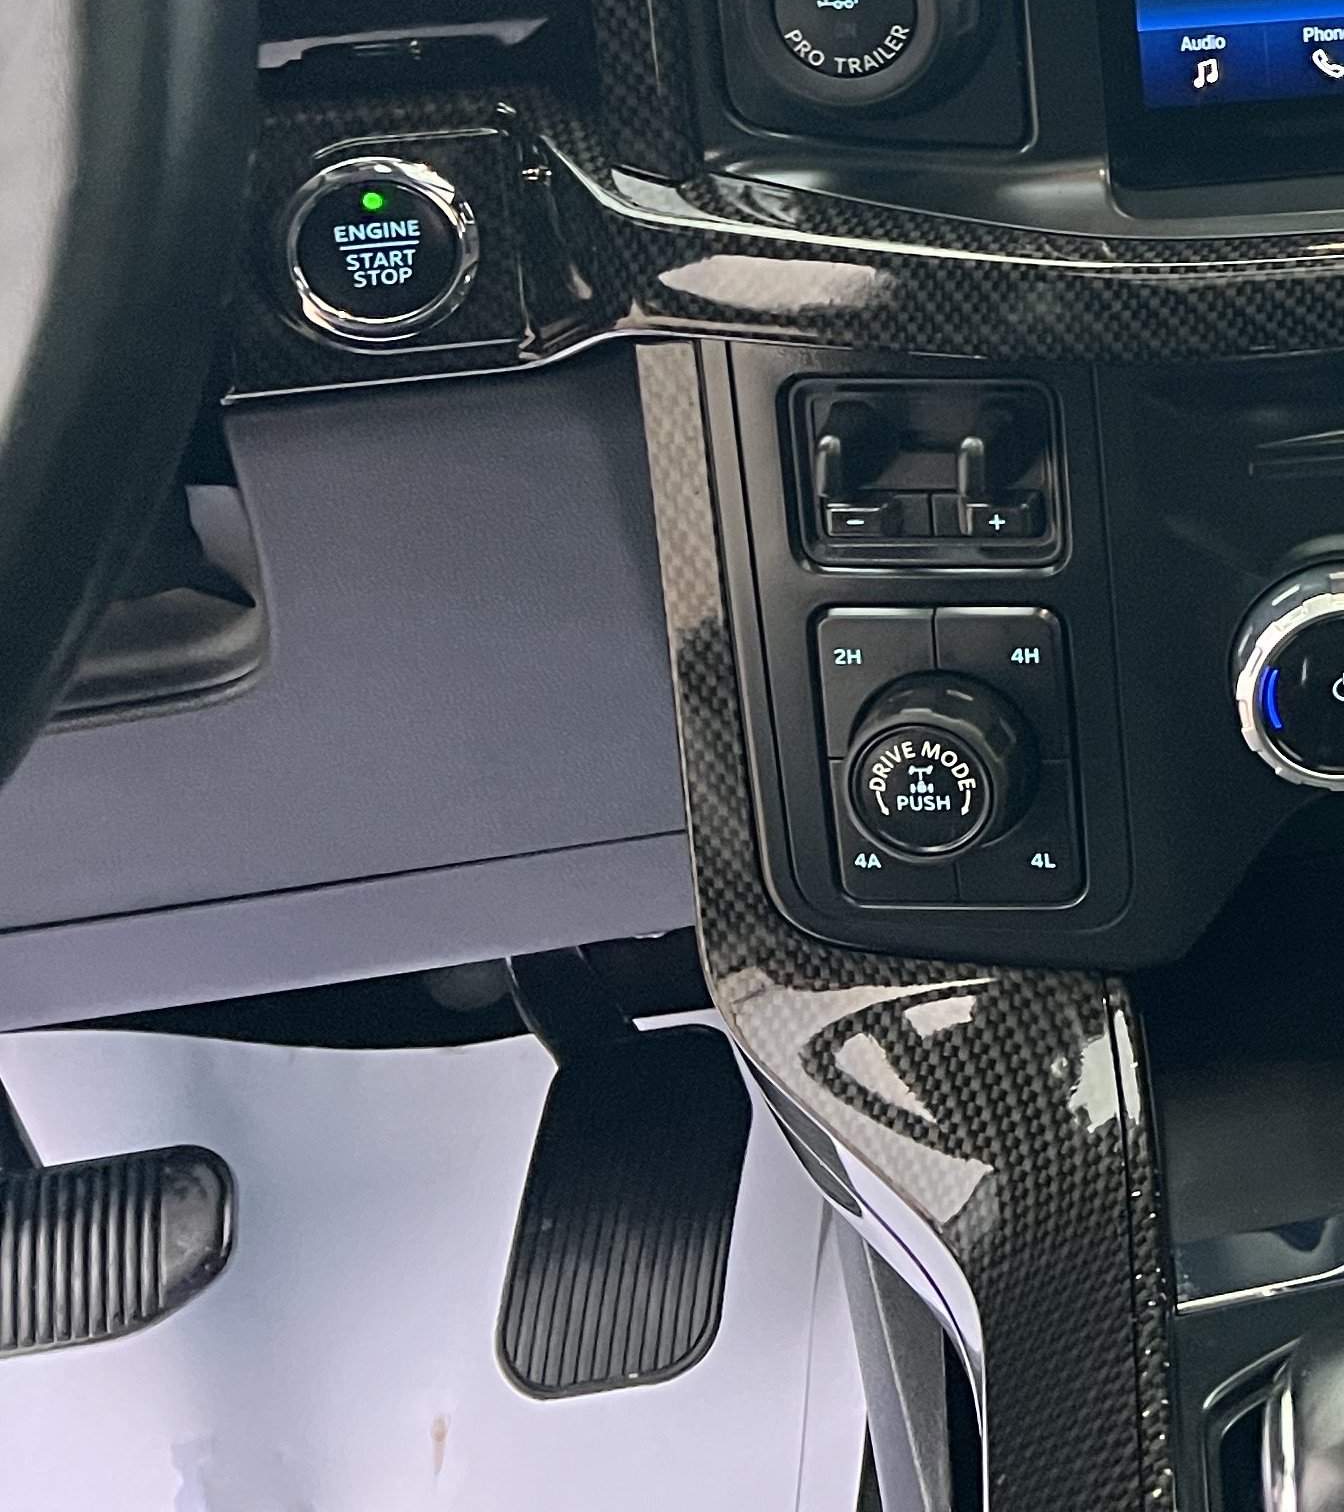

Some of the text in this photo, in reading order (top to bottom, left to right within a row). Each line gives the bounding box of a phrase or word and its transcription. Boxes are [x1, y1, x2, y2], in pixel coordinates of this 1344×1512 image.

[784, 24, 910, 74] PRO TRAILER
[1180, 34, 1226, 53] Audio
[333, 219, 421, 243] ENGINE
[346, 248, 416, 271] START
[353, 267, 412, 288] STOP
[833, 648, 862, 665] 2H
[1010, 648, 1040, 664] 4H
[869, 740, 977, 792] DRIVE MODE
[897, 794, 951, 811] PUSH
[854, 853, 882, 869] 4A
[1030, 853, 1056, 869] 4L
